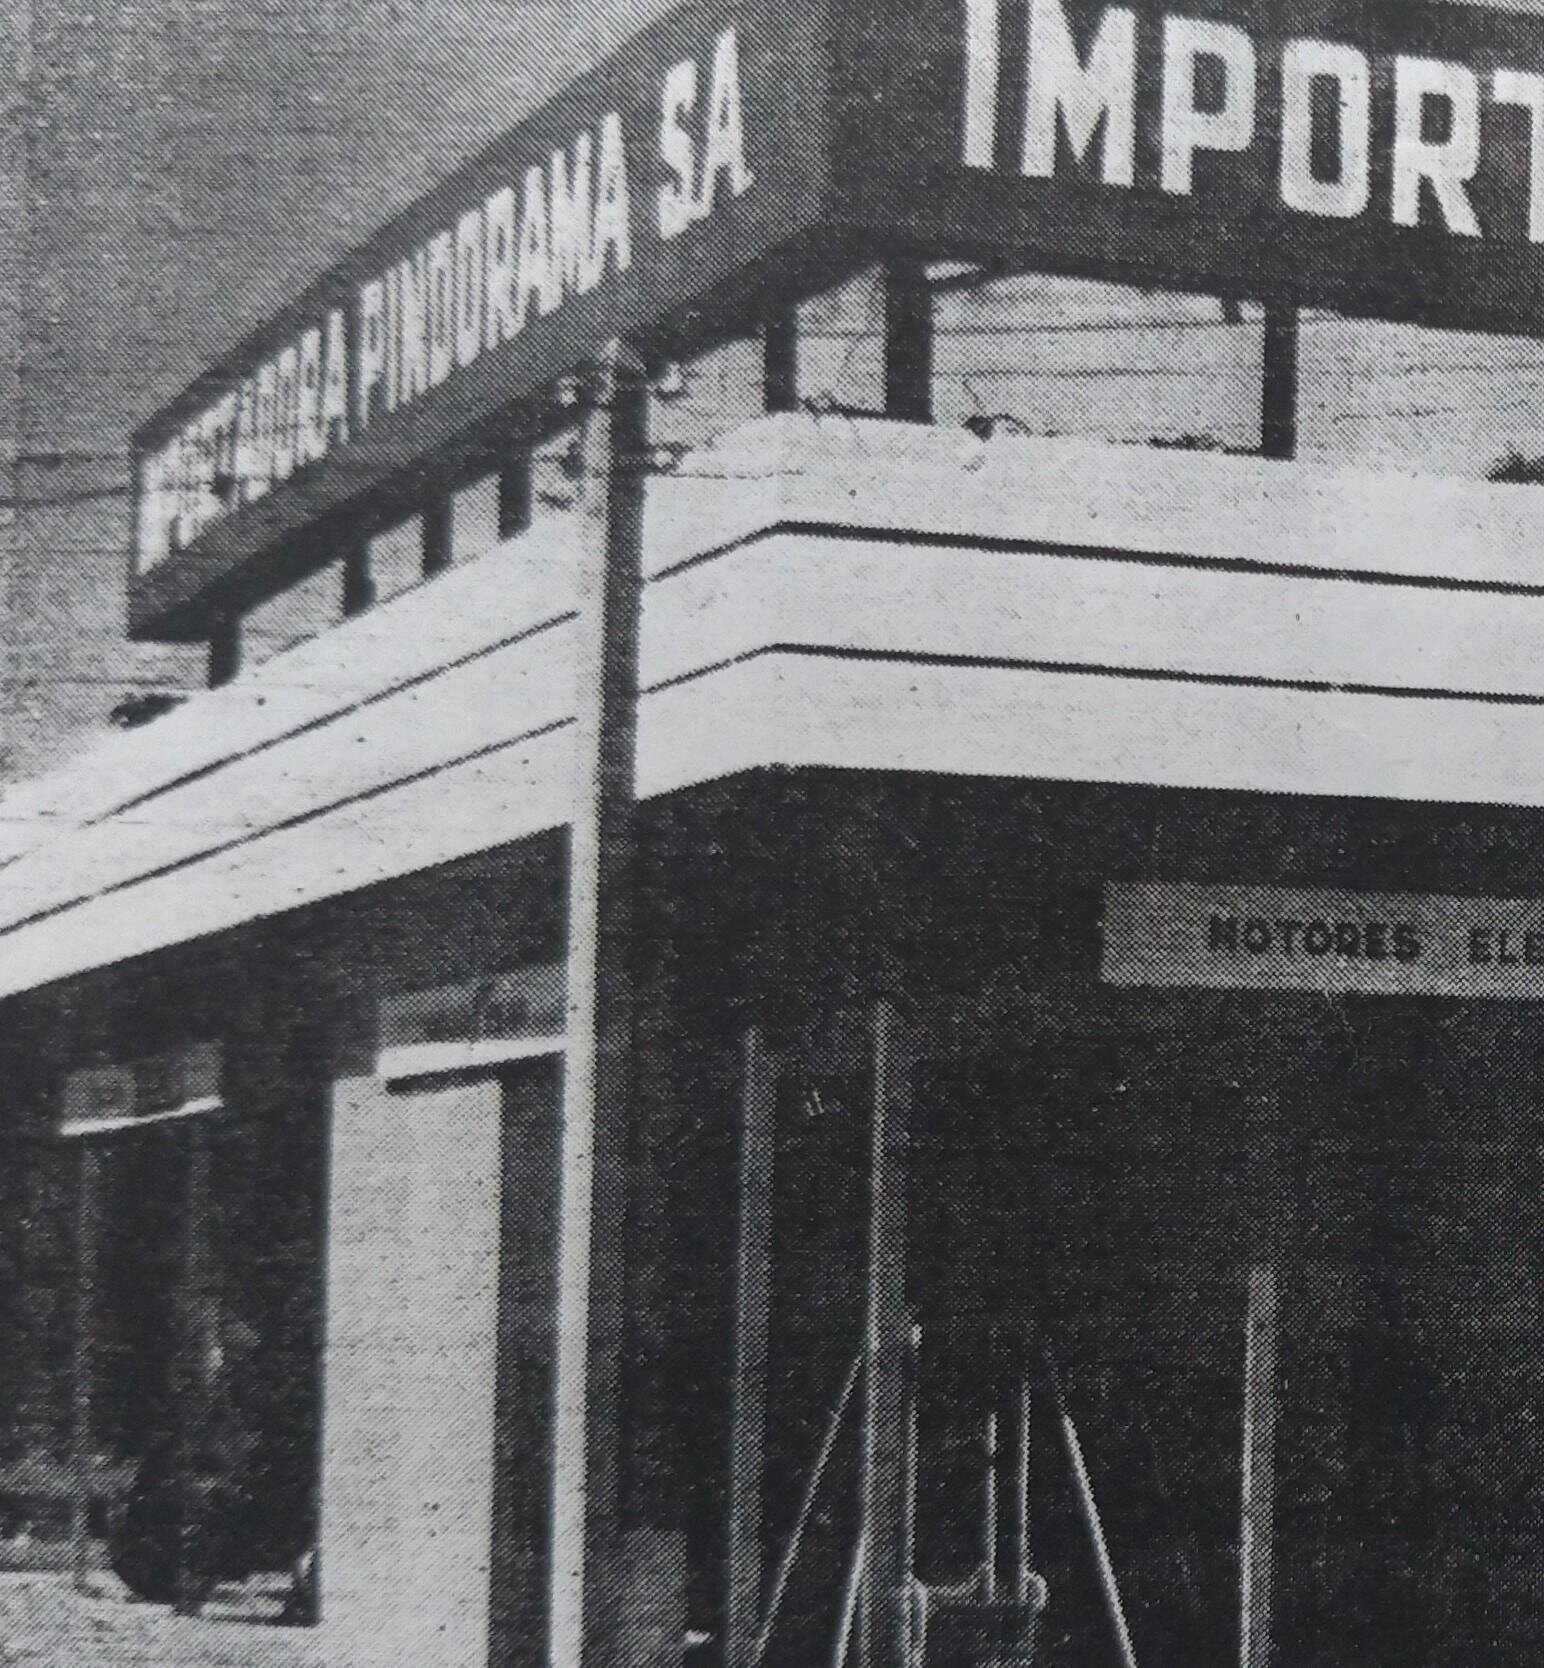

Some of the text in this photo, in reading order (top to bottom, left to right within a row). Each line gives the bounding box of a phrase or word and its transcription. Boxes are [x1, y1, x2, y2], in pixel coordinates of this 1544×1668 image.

[359, 112, 631, 430] PINDORAMA
[658, 26, 754, 241] SA
[1207, 914, 1421, 964] MOTORES
